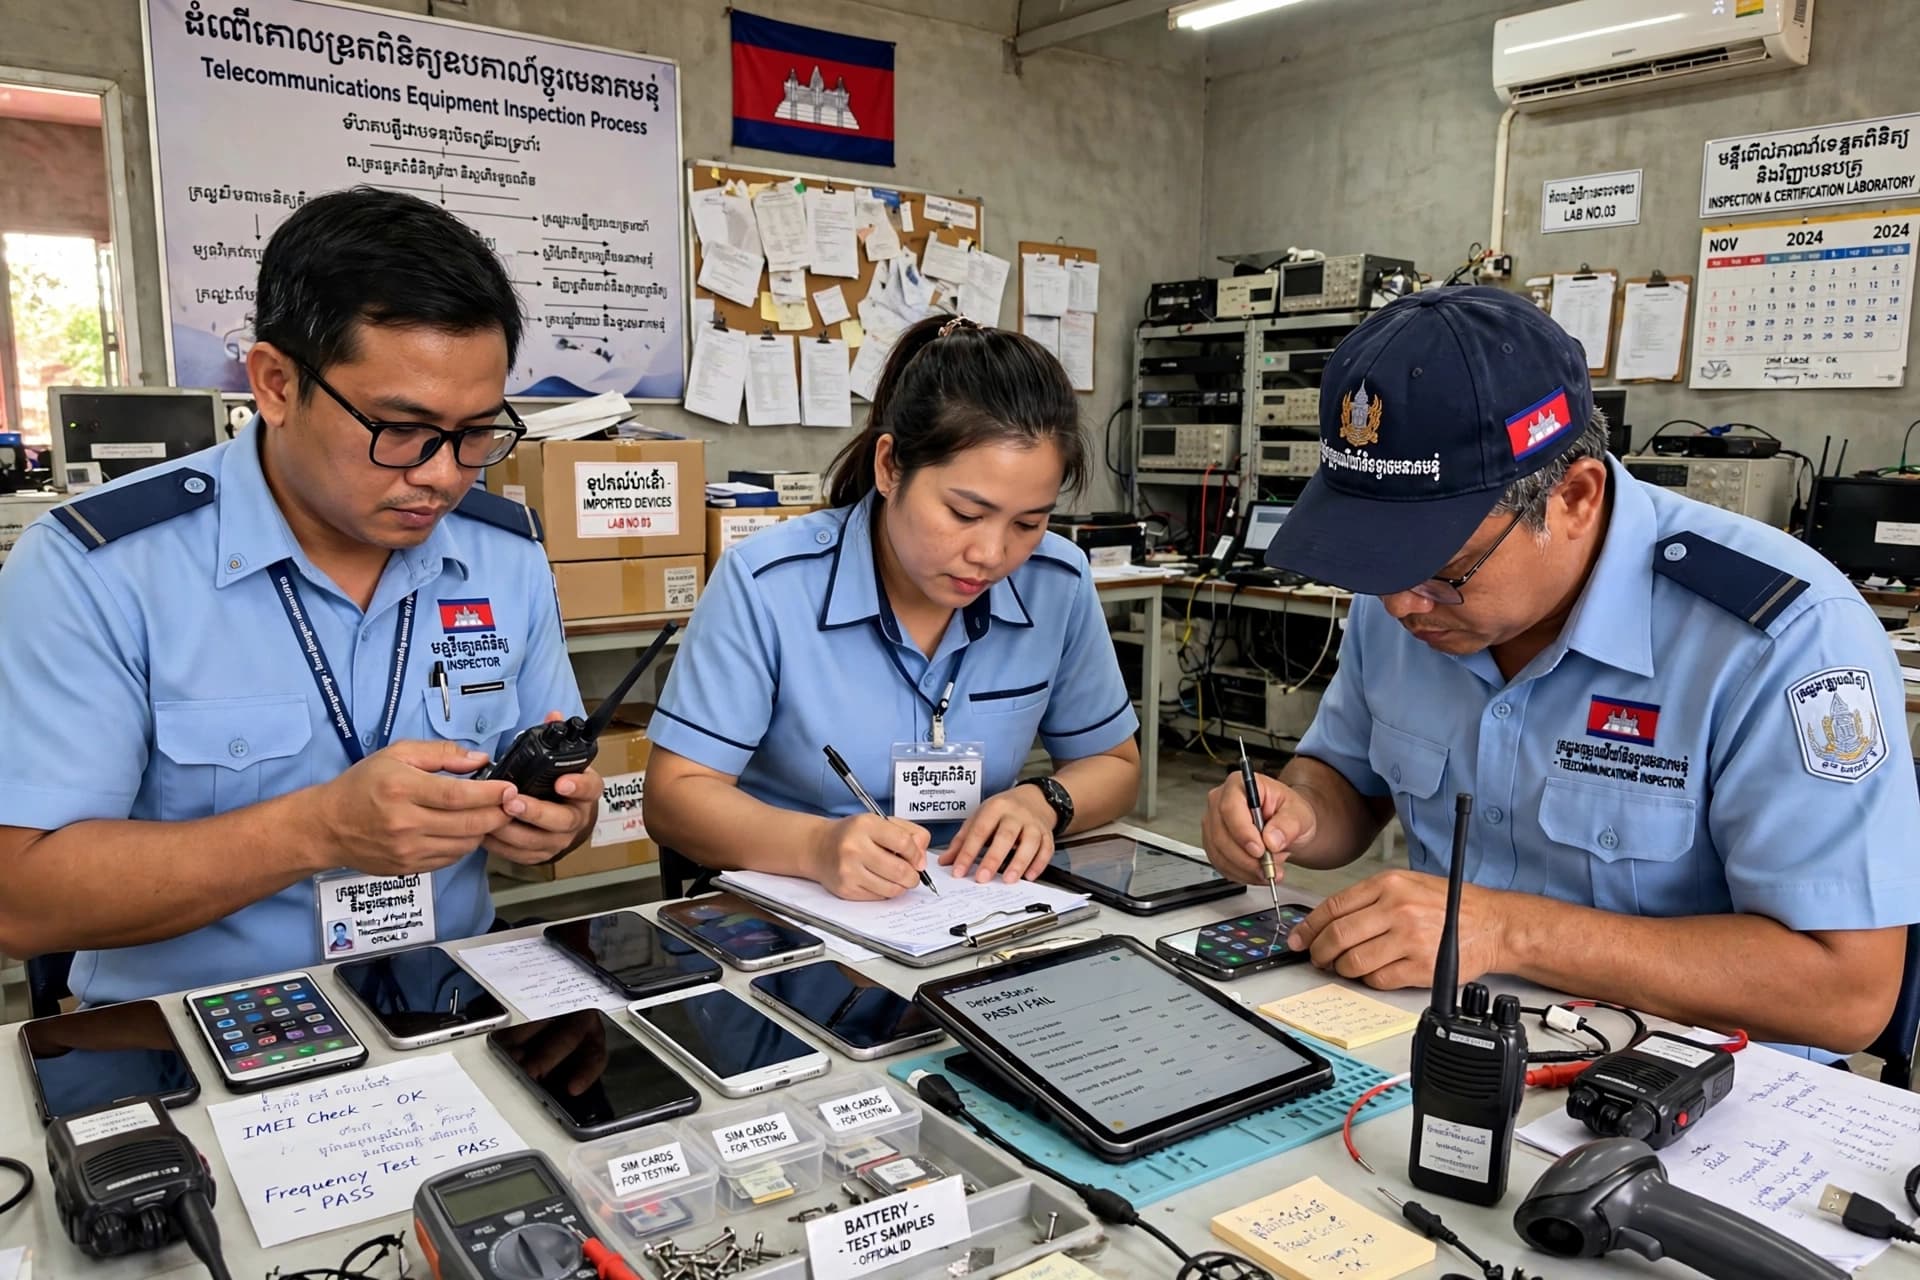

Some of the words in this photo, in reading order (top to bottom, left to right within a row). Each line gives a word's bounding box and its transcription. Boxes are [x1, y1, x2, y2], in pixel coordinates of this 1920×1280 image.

[201, 56, 401, 102] Telecommunications
[406, 85, 499, 115] Equipment
[504, 99, 586, 127] Inspection
[591, 111, 648, 135] Process
[1708, 191, 1763, 209] INSPECTION
[1764, 191, 1771, 203] &
[1774, 181, 1846, 202] CERTIFICATION
[1847, 175, 1916, 195] LABORATORY
[1564, 208, 1583, 222] LAB
[1709, 237, 1739, 253] NOV
[1786, 230, 1824, 247] 2024
[1873, 223, 1910, 240] 2024
[583, 497, 632, 510] IMPORTED
[634, 496, 672, 509] DEVICES
[608, 517, 625, 528] LAB
[626, 517, 640, 528] NO
[446, 656, 501, 671] INSPECTOR
[1639, 773, 1685, 790] INSPECTOR
[909, 801, 966, 812] INSPECTOR
[982, 1005, 1018, 1022] PASS
[1023, 995, 1056, 1009] FAIL
[242, 1116, 296, 1140] IMEI
[306, 1104, 359, 1124] Check
[396, 1089, 427, 1105] OK
[832, 1103, 851, 1116] SIM
[852, 1095, 882, 1110] CARDS
[840, 1114, 858, 1126] FOR
[858, 1104, 893, 1120] TESTING
[724, 1130, 745, 1142] SIM
[745, 1120, 778, 1136] CARDS
[730, 1142, 750, 1154] FOR
[749, 1131, 787, 1149] TESTING
[264, 1170, 368, 1204] Frequency
[376, 1155, 421, 1176] Test
[457, 1137, 500, 1157] PASS
[620, 1160, 639, 1173] SIM
[641, 1150, 674, 1167] CARDS
[621, 1173, 641, 1188] FOR
[641, 1163, 680, 1180] TESTING
[321, 1184, 375, 1210] PASS
[844, 1201, 909, 1235] BATTERY
[846, 1231, 878, 1253] TEST
[880, 1213, 935, 1243] SAMPLES
[858, 1245, 899, 1266] OFFICIAL
[900, 1239, 911, 1253] ID
